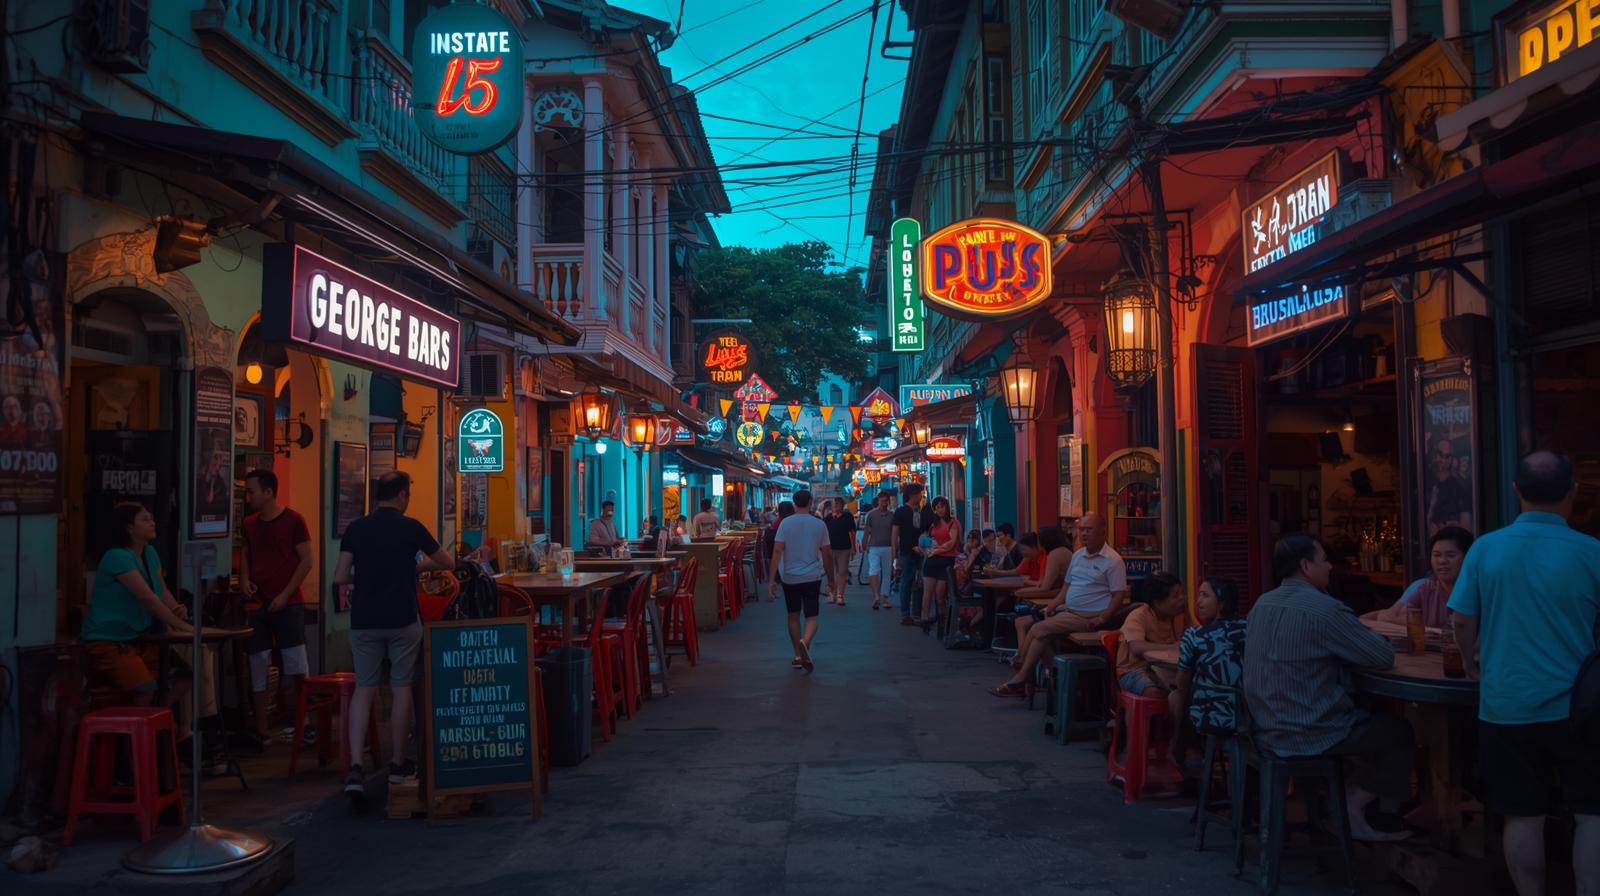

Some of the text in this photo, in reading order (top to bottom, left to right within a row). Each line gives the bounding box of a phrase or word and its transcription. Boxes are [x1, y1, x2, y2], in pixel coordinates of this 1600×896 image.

[431, 31, 510, 54] INSTATE
[311, 273, 450, 371] GEORGE BARS
